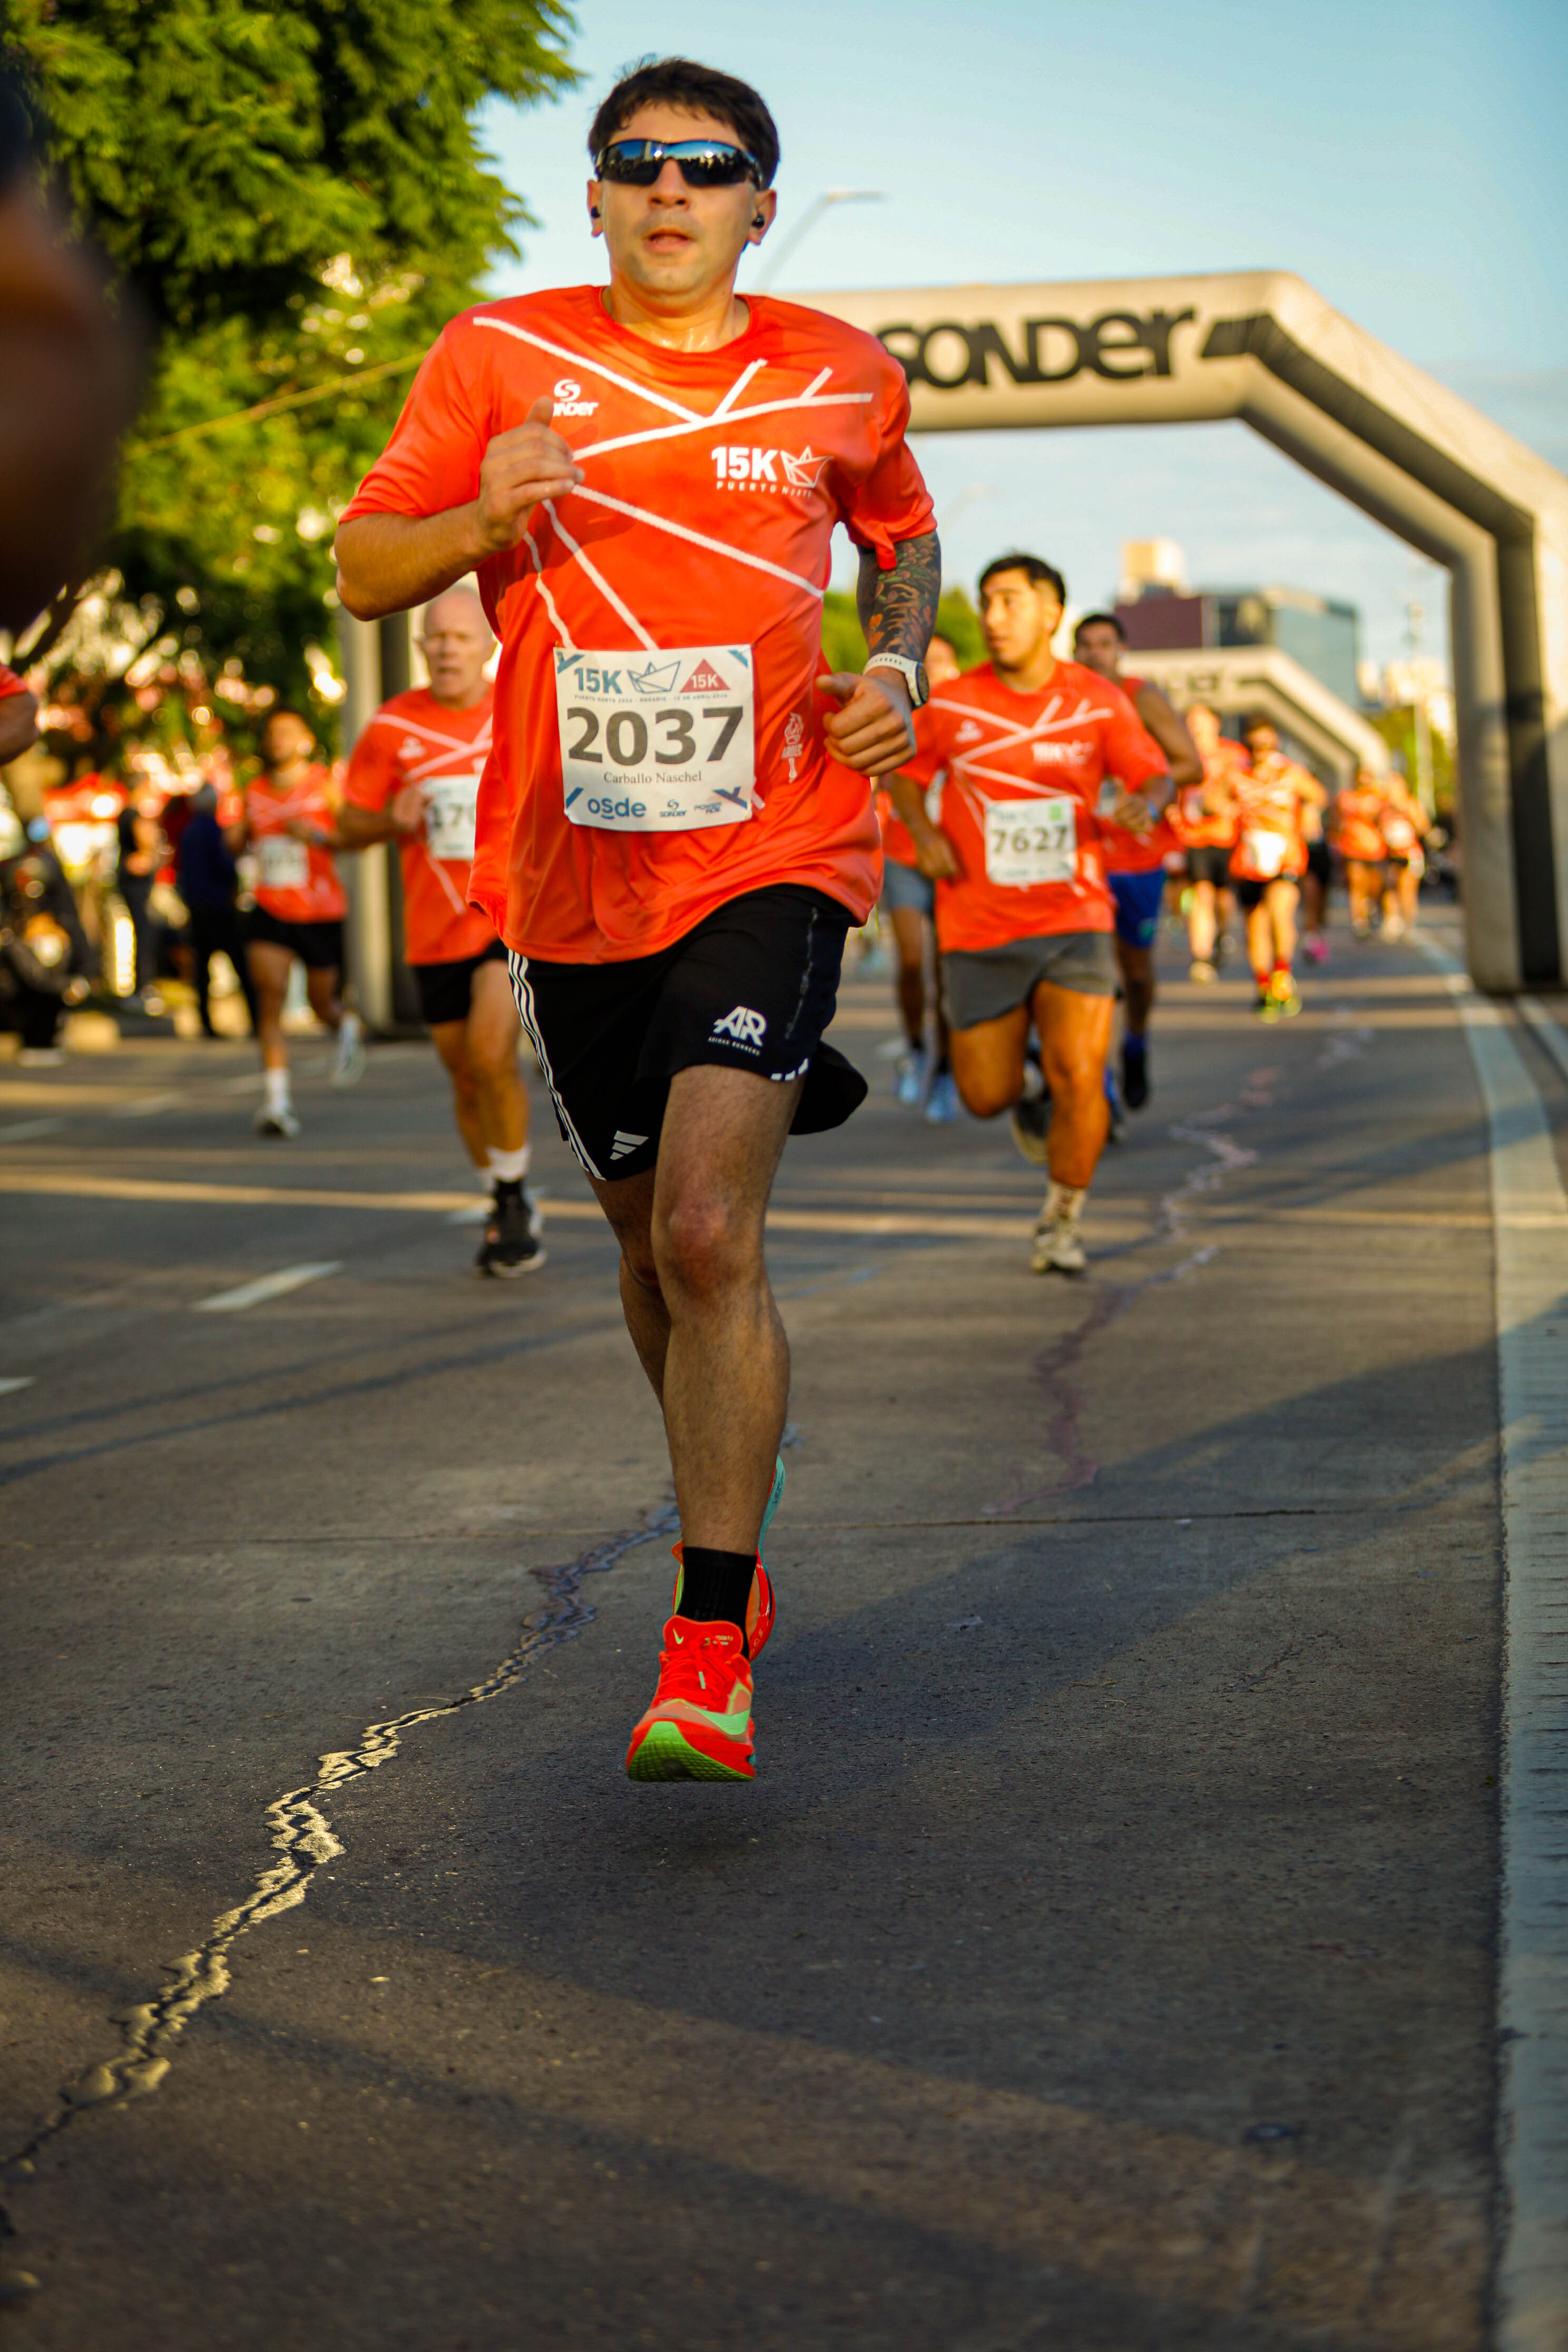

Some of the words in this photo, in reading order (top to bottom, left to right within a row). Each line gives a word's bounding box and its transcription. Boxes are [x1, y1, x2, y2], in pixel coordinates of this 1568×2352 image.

[711, 446, 778, 482] 15K
[717, 480, 777, 494] PUERTO
[574, 668, 622, 694] 15K
[691, 673, 720, 688] 15K
[566, 705, 743, 767] 2037
[603, 771, 652, 784] Carballo
[655, 770, 702, 783] Naschel
[587, 796, 646, 819] osde
[989, 825, 1067, 855] 7627
[712, 1005, 767, 1047] AR
